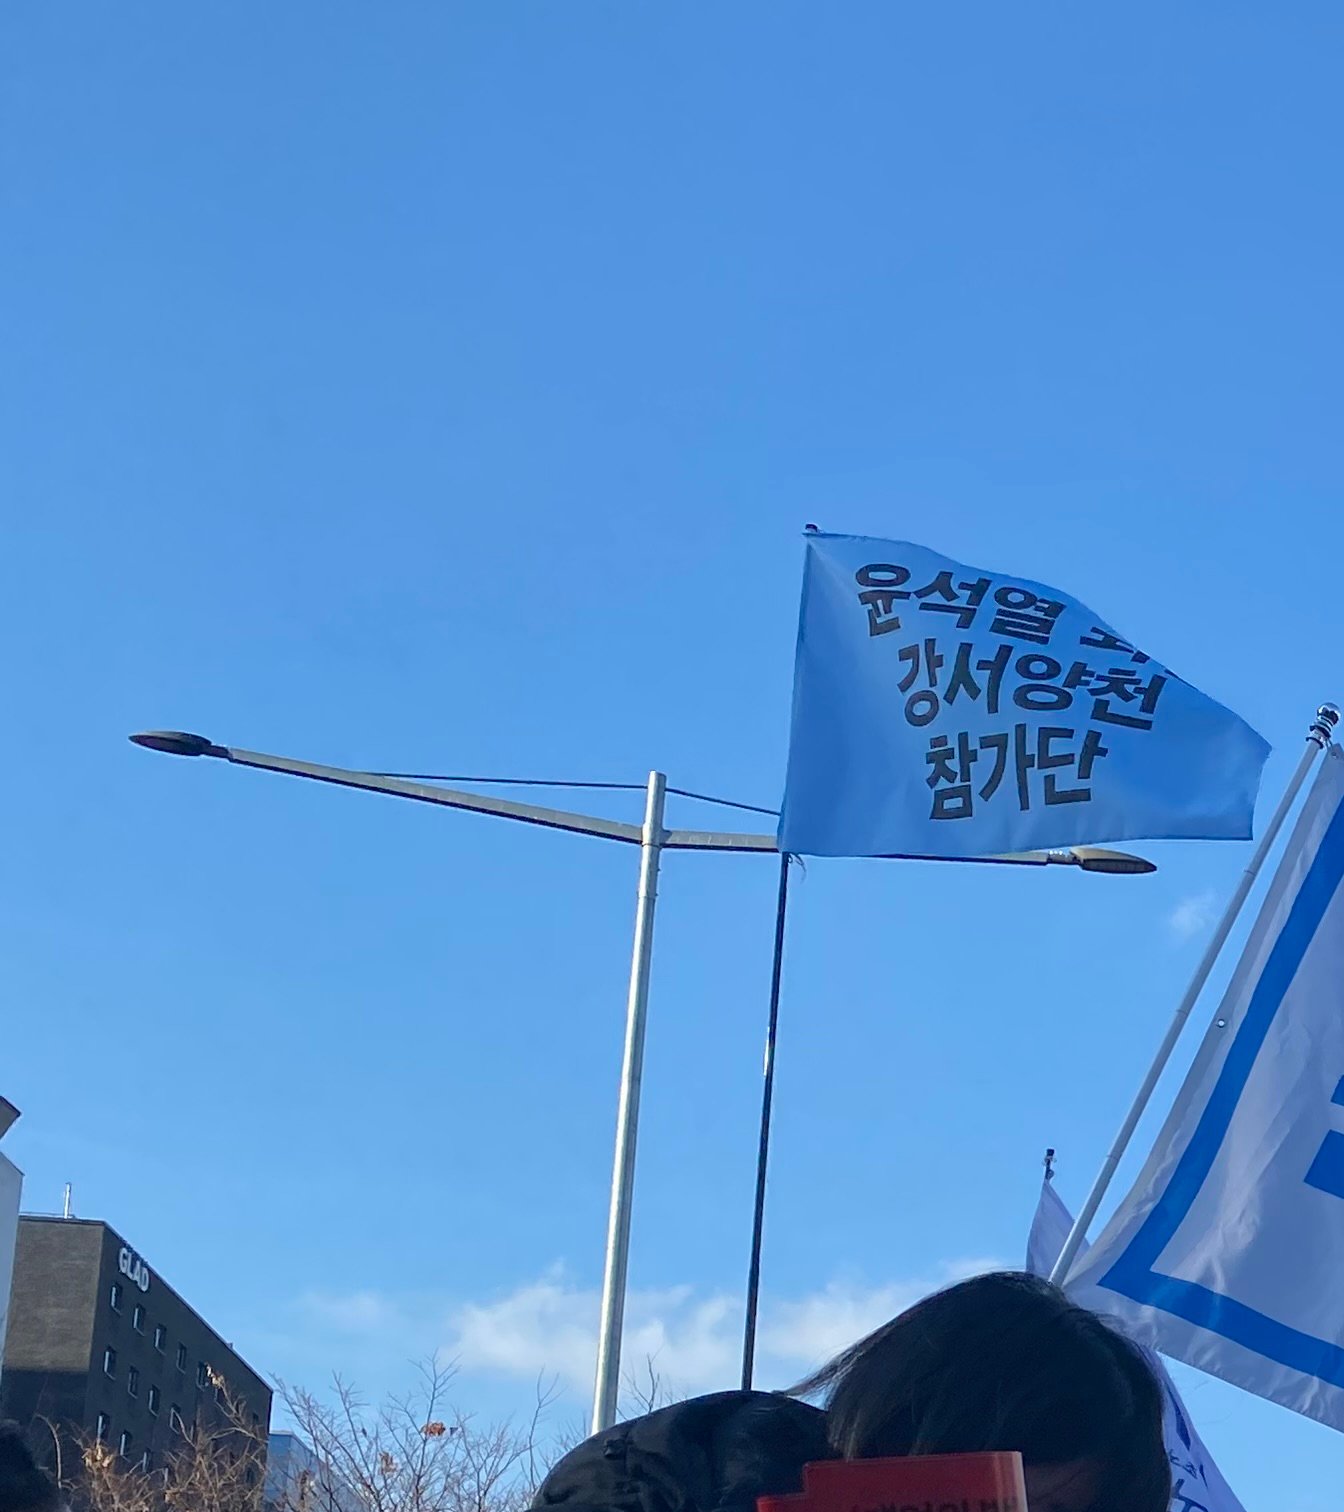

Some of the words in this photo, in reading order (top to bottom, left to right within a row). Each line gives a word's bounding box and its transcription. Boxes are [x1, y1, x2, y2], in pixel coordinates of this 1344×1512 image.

[855, 563, 1066, 645] 윤석열
[896, 637, 1169, 731] 강서양천
[925, 723, 1109, 820] 참가단
[118, 1246, 150, 1293] GLAD
